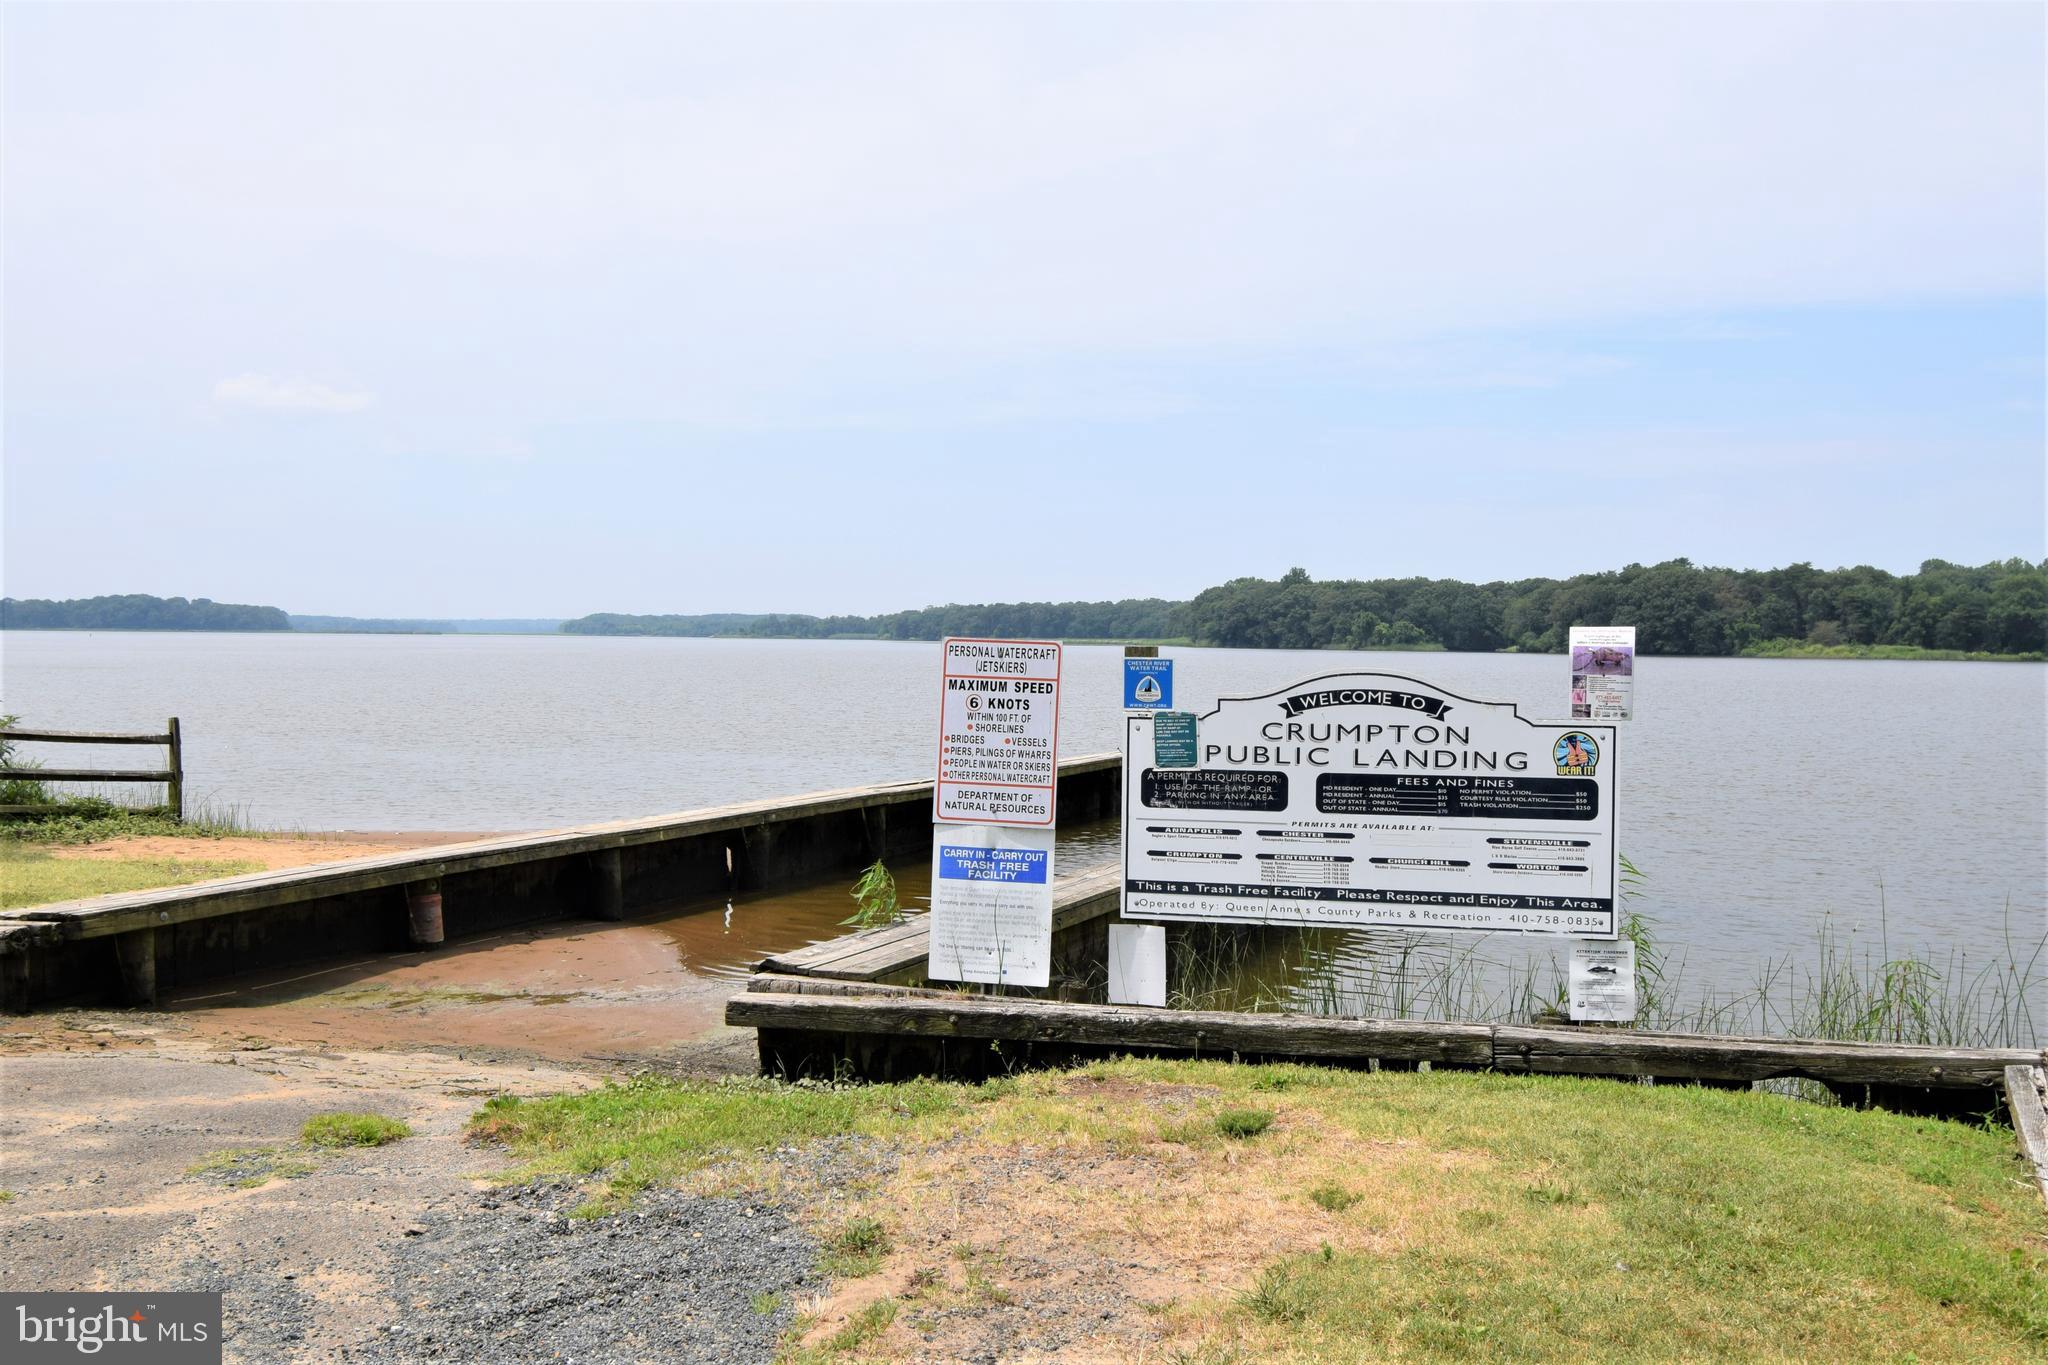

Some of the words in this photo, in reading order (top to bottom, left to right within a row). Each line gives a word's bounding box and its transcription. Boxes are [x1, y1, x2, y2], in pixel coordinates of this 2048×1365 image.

[949, 646, 995, 658] PERSONAL
[997, 647, 1056, 660] WATERCRAFT
[976, 661, 1028, 675] (JETSKIERS)
[948, 679, 1007, 692] MAXIMUM
[1014, 682, 1053, 694] SPEED
[970, 697, 978, 708] 6
[988, 698, 1030, 710] KNOTS
[1299, 691, 1392, 708] WELCOME
[1400, 694, 1426, 710] TO
[967, 712, 994, 722] WITHIN
[996, 713, 1007, 722] 100
[1009, 714, 1020, 722] FT.
[1021, 714, 1032, 723] OF
[975, 723, 1024, 734] SHORELINES
[1261, 722, 1470, 746] CRUMPTON
[950, 735, 985, 744] BRIDGES
[1012, 737, 1047, 747] VESSELS
[950, 746, 974, 757] PIERS,
[976, 748, 1005, 758] PILINGS
[1006, 749, 1016, 758] OF
[1018, 750, 1051, 760] WHARFS
[1205, 744, 1330, 767] PUBLIC
[1353, 748, 1528, 771] LANDING
[950, 758, 977, 768] PEOPLE
[978, 759, 986, 768] IN
[987, 760, 1011, 770] WATER
[1013, 761, 1023, 770] OR
[1024, 762, 1051, 772] SKIERS
[1558, 766, 1583, 776] WEAR
[1584, 766, 1595, 776] IT!
[949, 770, 970, 780] OTHER
[970, 772, 1006, 782] PERSONAL
[1006, 773, 1050, 784] WATERCRAFT
[1157, 772, 1192, 780] PERMIT
[1204, 773, 1255, 782] REQUIRED
[1397, 777, 1429, 786] FEES
[1436, 778, 1468, 787] AND
[1475, 779, 1514, 788] FINES
[958, 790, 1018, 802] DEPARTMENT
[1021, 793, 1033, 803] OF
[945, 801, 987, 812] NATURAL
[990, 803, 1046, 814] RESOURCES
[944, 848, 974, 858] CARRY
[976, 850, 985, 859] IN
[992, 850, 1024, 860] CARRY
[1025, 852, 1044, 861] OUT
[957, 860, 995, 870] TRASH
[1000, 862, 1029, 871] FREE
[968, 870, 1017, 880] FACILITY
[1136, 881, 1162, 892] This
[1167, 883, 1176, 892] is
[1195, 884, 1232, 895] Trash
[1238, 886, 1269, 896] Free
[1337, 889, 1380, 900] Please
[1387, 892, 1444, 904] Respect
[1449, 894, 1474, 904] and
[1480, 896, 1518, 907] Enjoy
[1525, 897, 1554, 907] This
[1561, 899, 1602, 909] Area.
[1140, 898, 1195, 909] Operated
[1201, 901, 1219, 911] By:
[1226, 903, 1264, 912] Queen
[1318, 907, 1361, 917] County
[1368, 908, 1402, 919] Parks
[1409, 910, 1416, 919] &
[1423, 911, 1491, 921] Recreation
[1509, 914, 1598, 926] 410-758-0835
